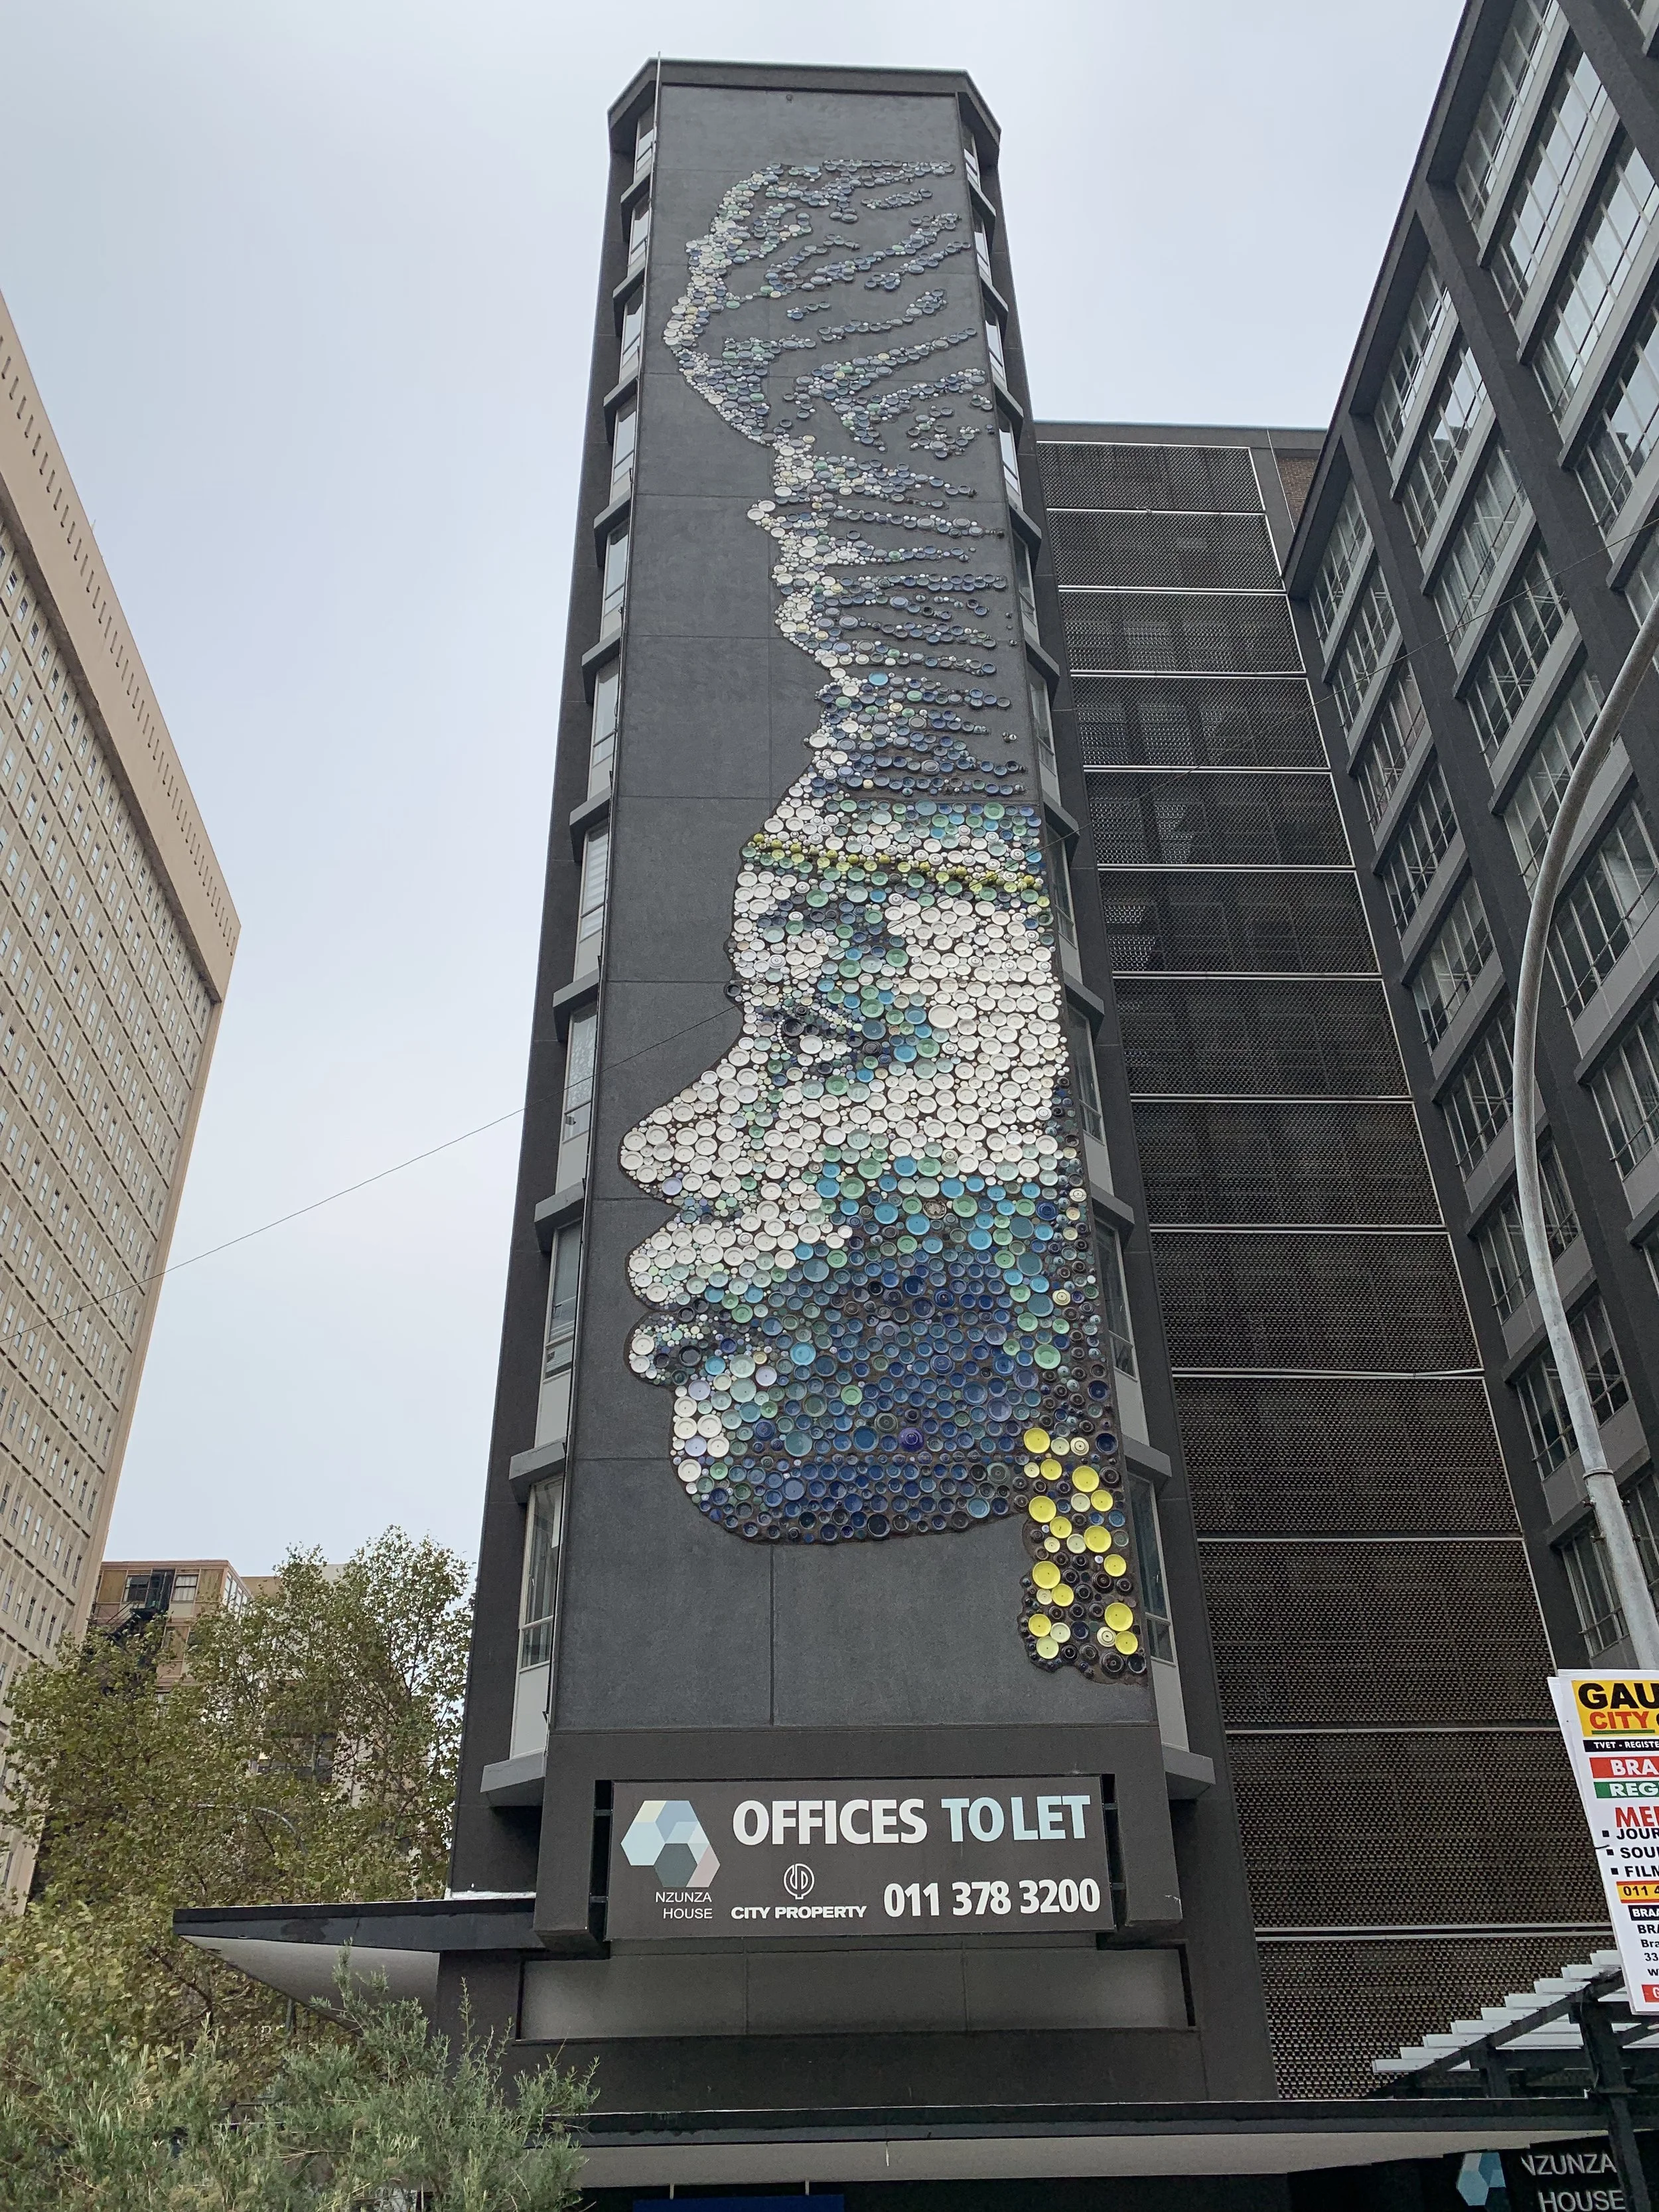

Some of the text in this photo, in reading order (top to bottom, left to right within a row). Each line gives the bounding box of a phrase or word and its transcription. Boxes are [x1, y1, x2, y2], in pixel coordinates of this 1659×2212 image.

[1578, 1682, 1659, 1710] GAU
[1589, 1711, 1649, 1730] CITY
[1610, 1759, 1659, 1776] BRA
[1609, 1782, 1659, 1797] REG
[732, 1795, 1091, 1846] OFFICES TO LET
[1620, 1846, 1659, 1859] SOU
[655, 1891, 712, 1903] NZUNZA
[883, 1878, 1101, 1917] 011 378 3200
[1623, 1885, 1648, 1896] 011
[663, 1907, 713, 1919] HOUSE
[731, 1905, 867, 1919] CITY PROPERTY
[1637, 1924, 1659, 1934] BR
[1644, 1953, 1658, 1961] 33
[1520, 2153, 1617, 2175] NZUNZA
[1538, 2189, 1626, 2212] HOUSE
